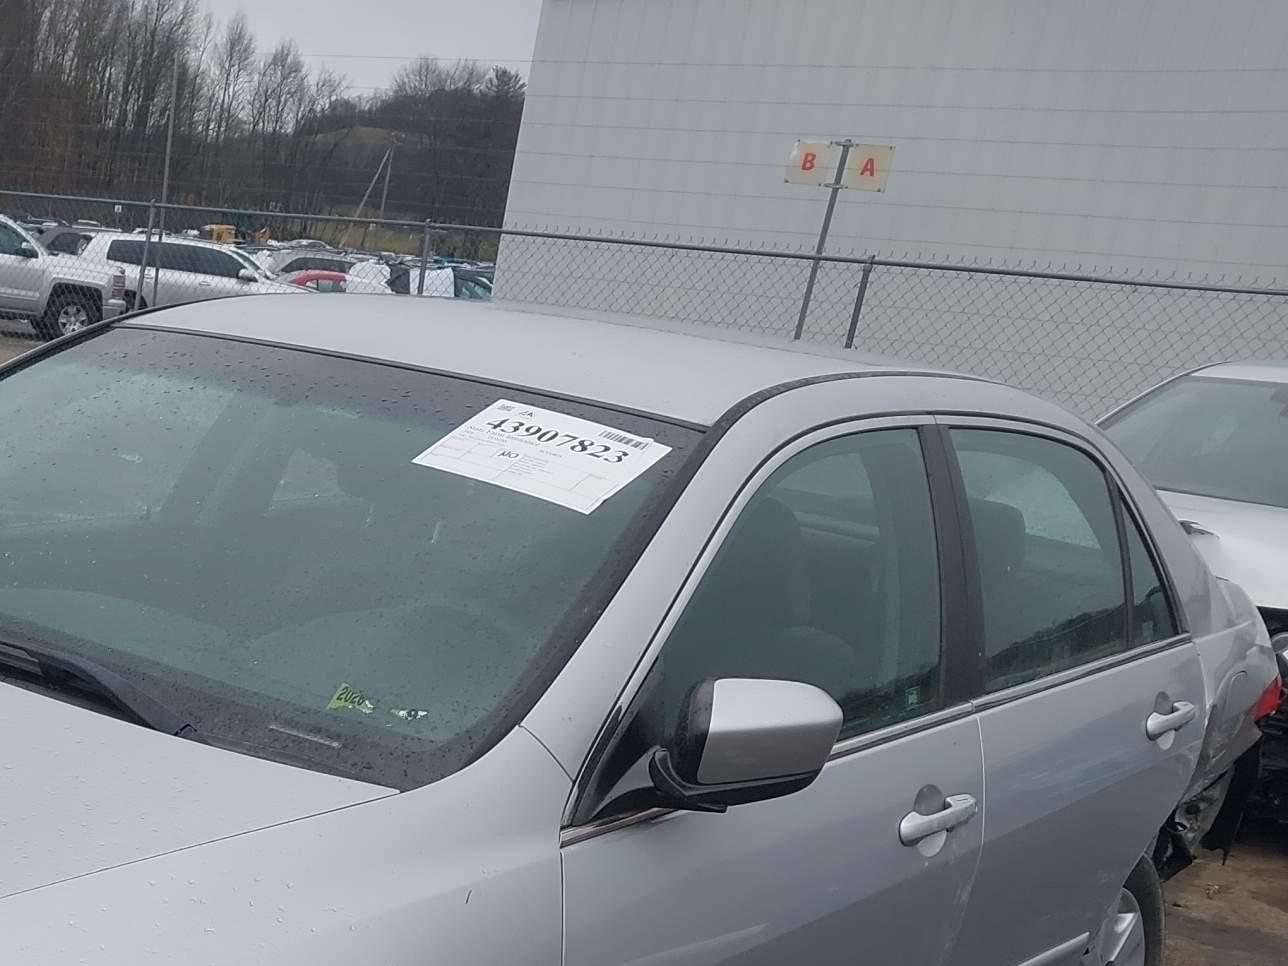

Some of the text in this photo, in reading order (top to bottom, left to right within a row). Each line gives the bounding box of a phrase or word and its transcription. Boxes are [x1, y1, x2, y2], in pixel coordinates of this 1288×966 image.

[801, 152, 817, 171] B
[860, 158, 875, 177] A
[486, 417, 630, 464] 43907823
